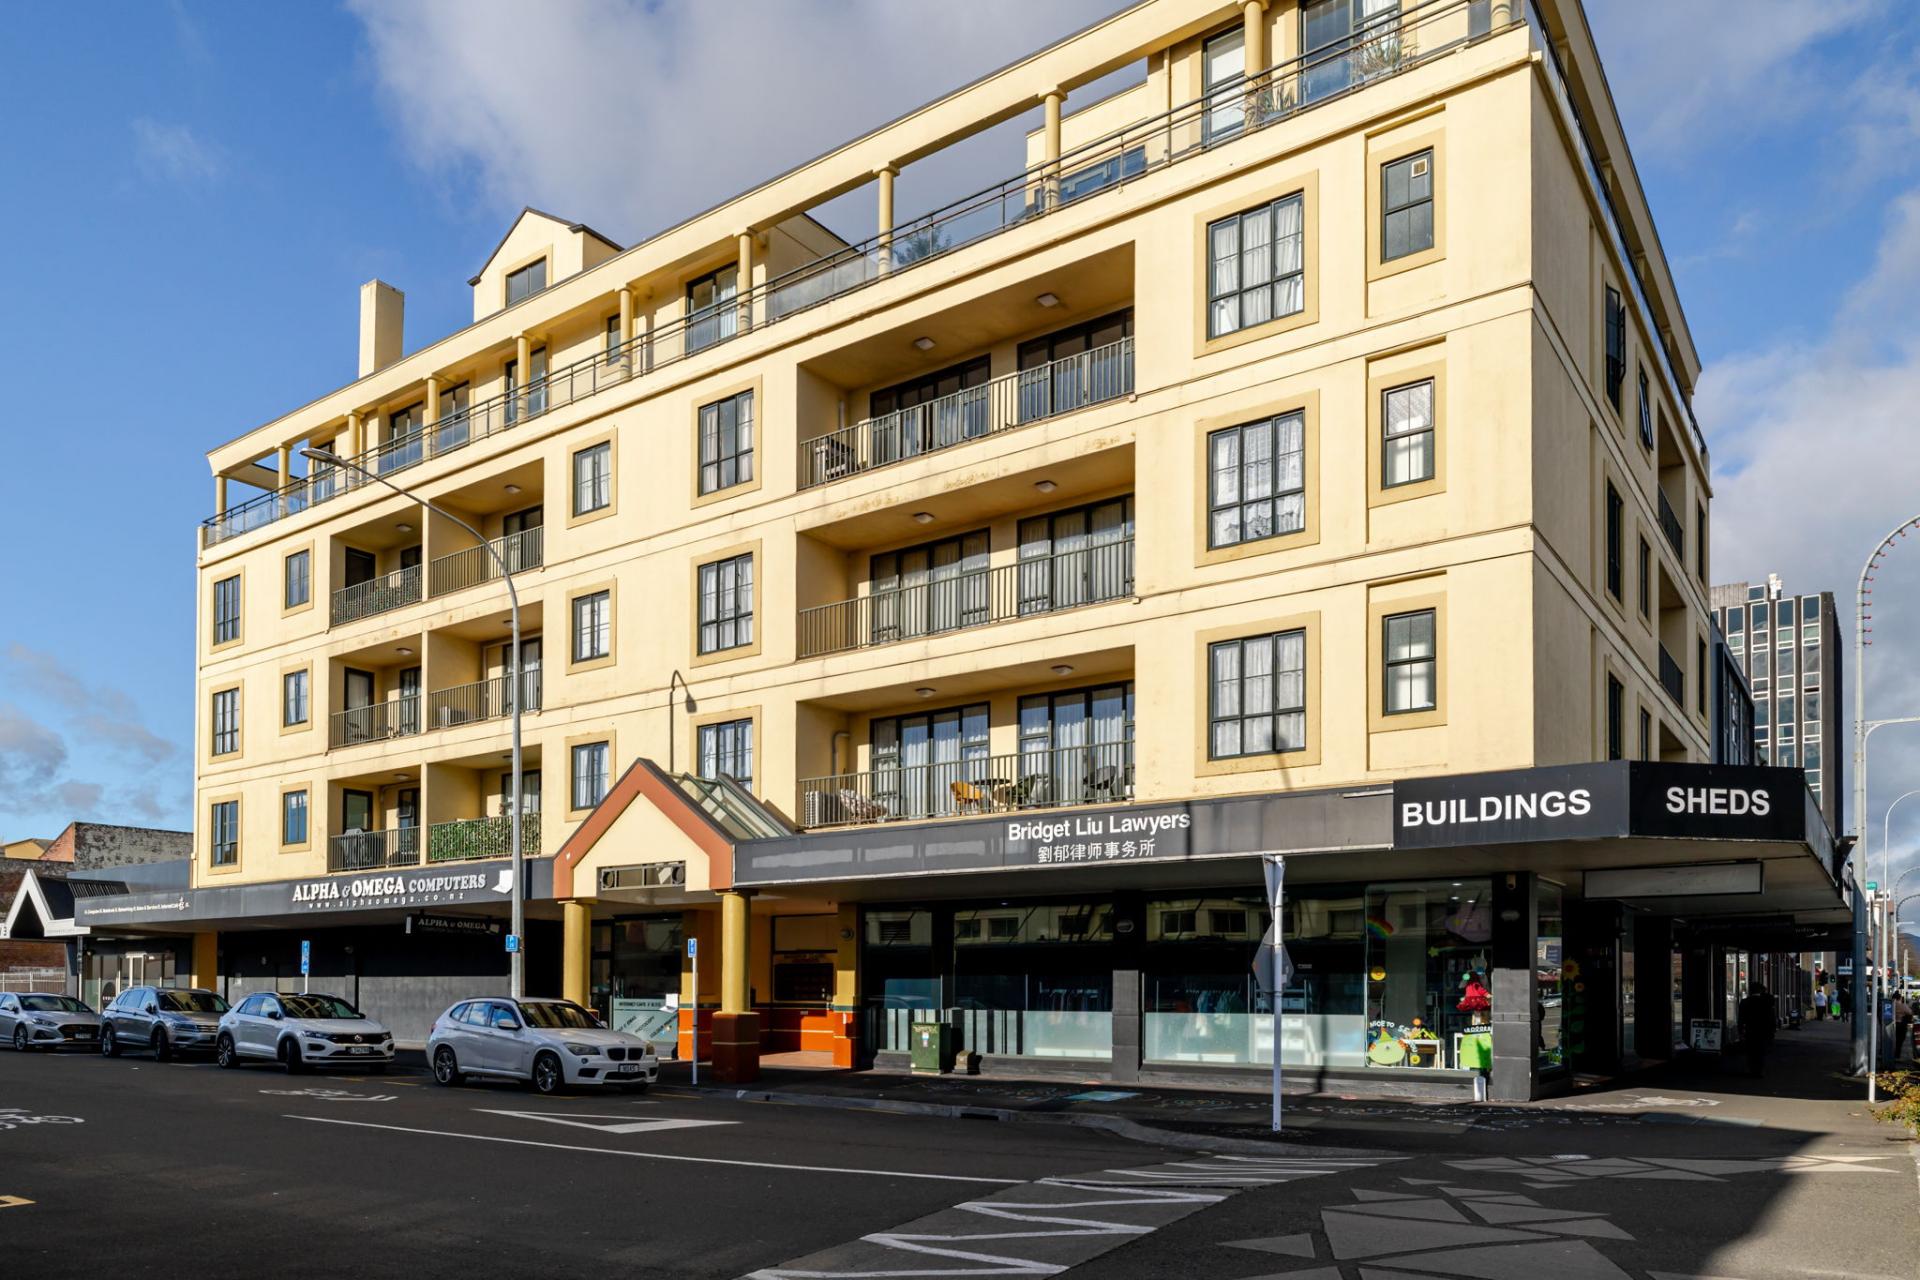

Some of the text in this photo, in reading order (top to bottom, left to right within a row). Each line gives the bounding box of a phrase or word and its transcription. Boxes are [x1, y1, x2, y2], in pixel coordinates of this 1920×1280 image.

[1401, 788, 1591, 827] BUILDINGS
[1665, 786, 1771, 816] SHEDS
[1008, 813, 1190, 843] Bridget Liu Lawyers
[292, 873, 487, 902] ALPHA & OMEGA COMPUTERS
